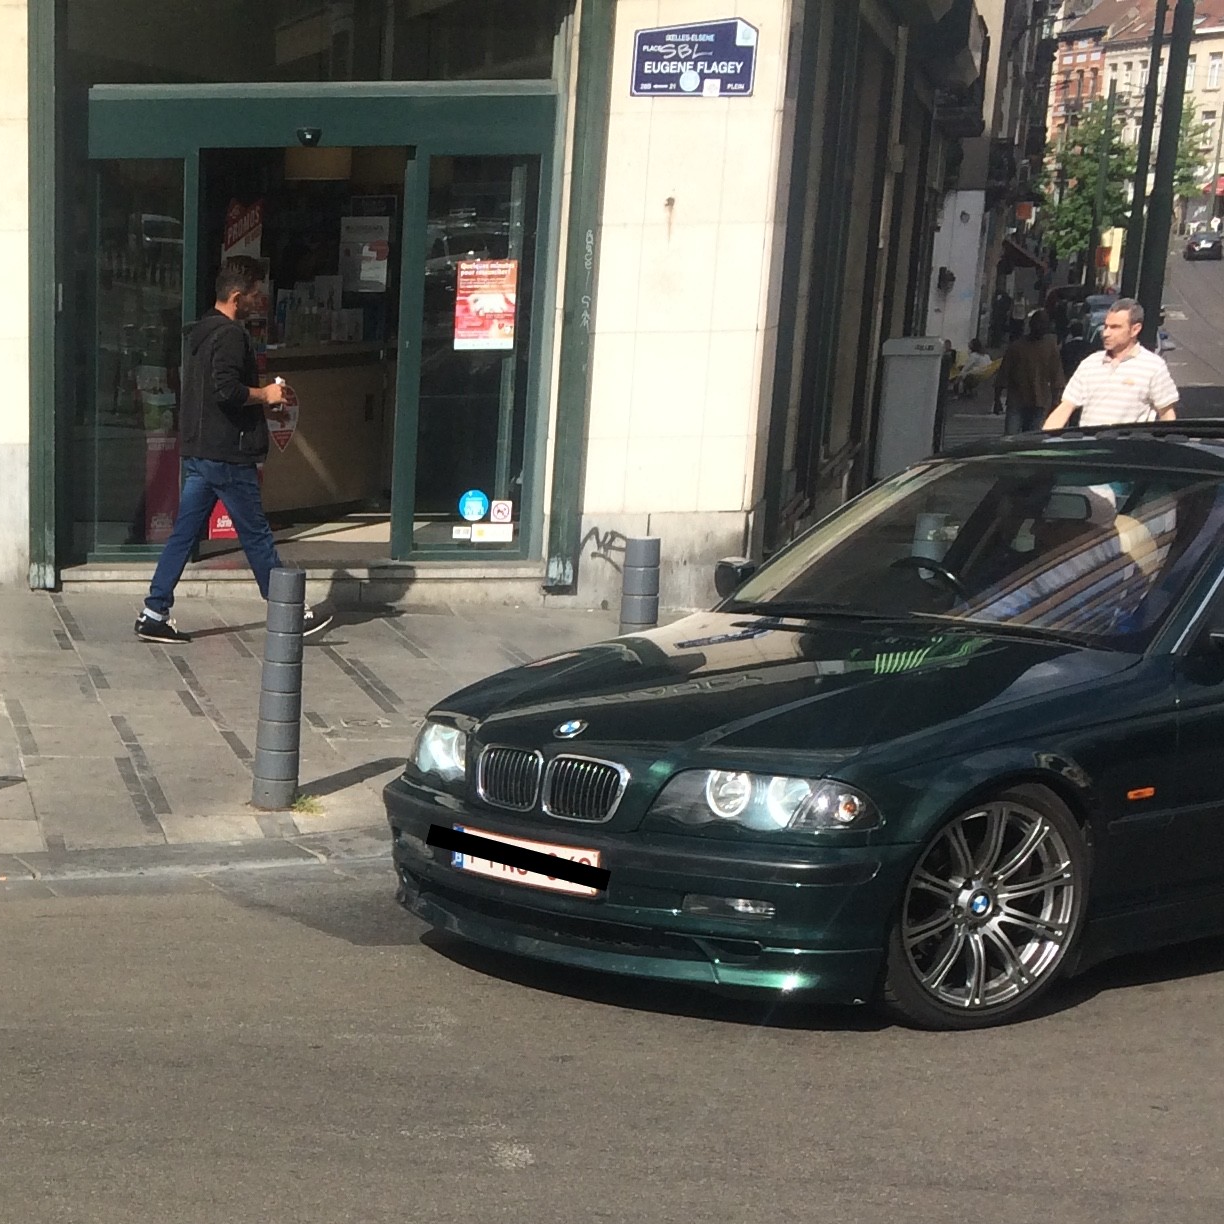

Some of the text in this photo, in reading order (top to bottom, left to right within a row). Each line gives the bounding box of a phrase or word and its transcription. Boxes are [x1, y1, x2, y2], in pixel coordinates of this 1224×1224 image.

[659, 43, 713, 59] SBL
[644, 61, 743, 74] EUGENE FLAGEY
